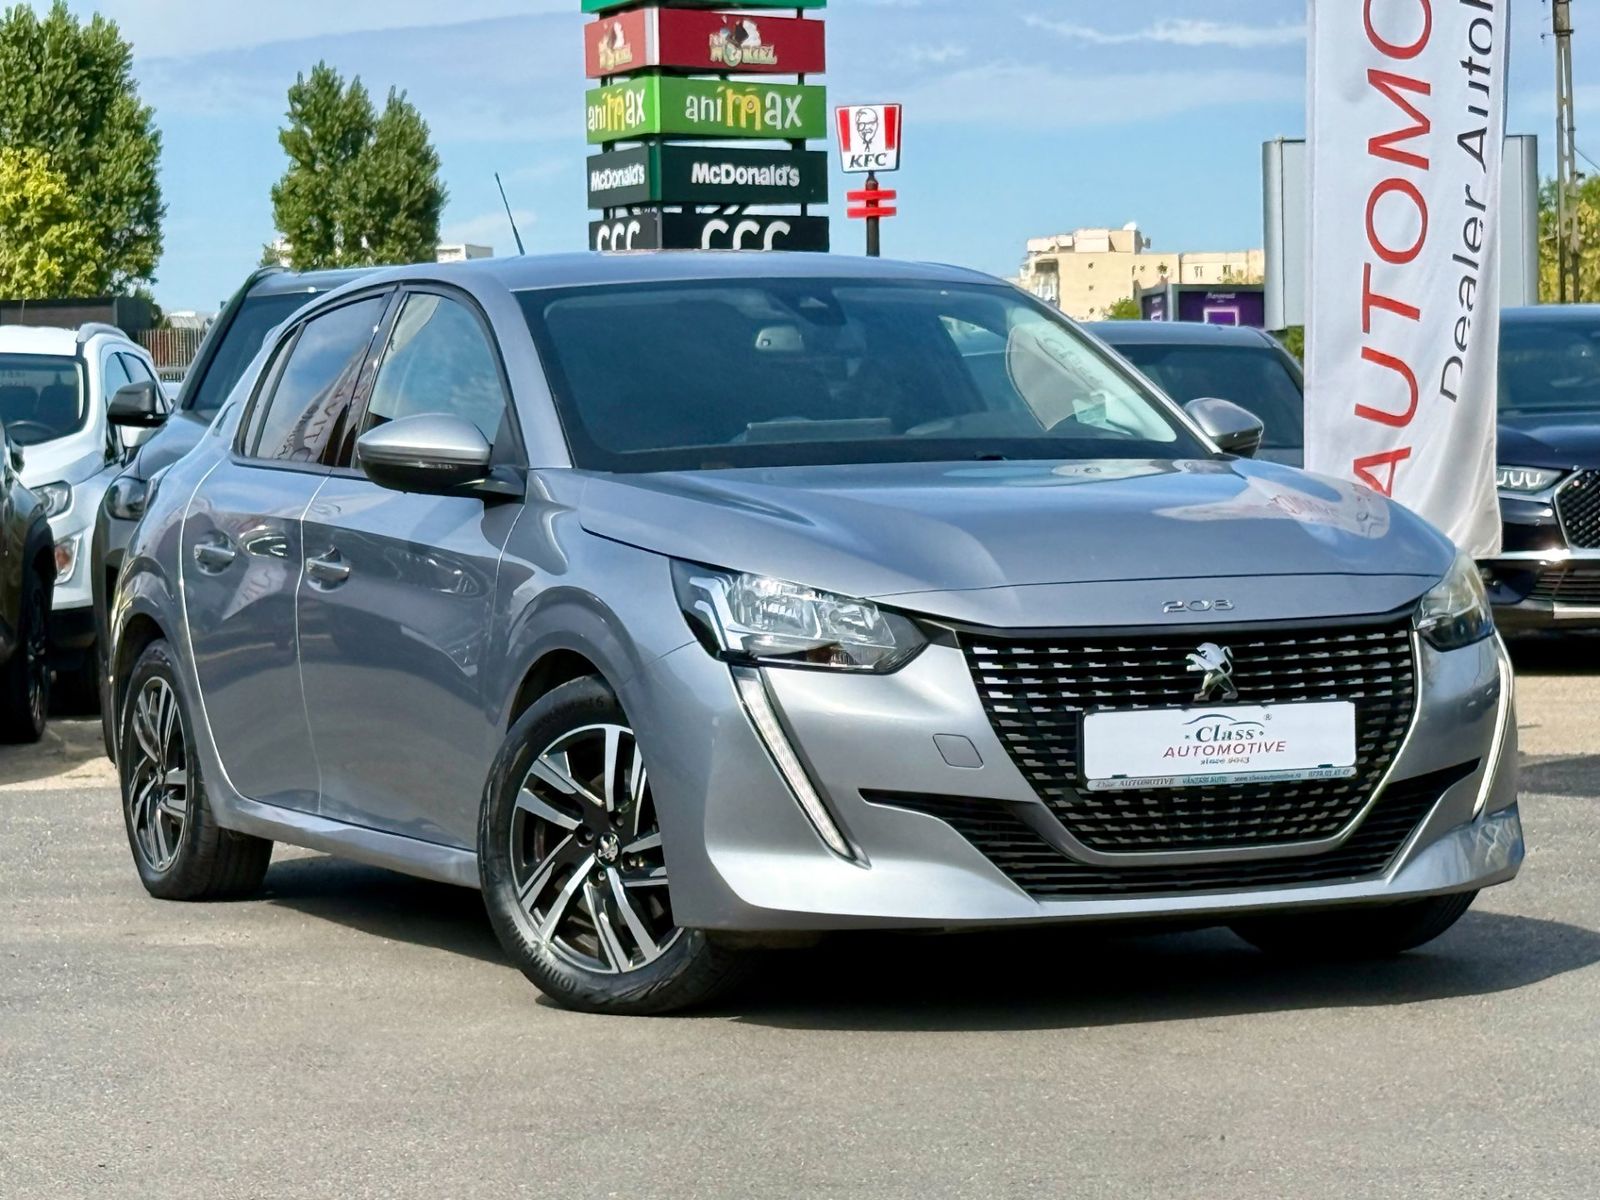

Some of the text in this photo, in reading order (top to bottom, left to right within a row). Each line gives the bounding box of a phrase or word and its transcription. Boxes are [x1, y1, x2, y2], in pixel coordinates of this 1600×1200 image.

[685, 86, 802, 131] animax
[849, 152, 888, 168] KFC
[591, 162, 645, 192] McDonald's
[691, 161, 800, 188] McDonald's
[1440, 183, 1486, 403] Dealer
[1161, 599, 1235, 613] 208
[1195, 724, 1255, 742] Class
[1163, 741, 1287, 758] AUTOMOTIVE
